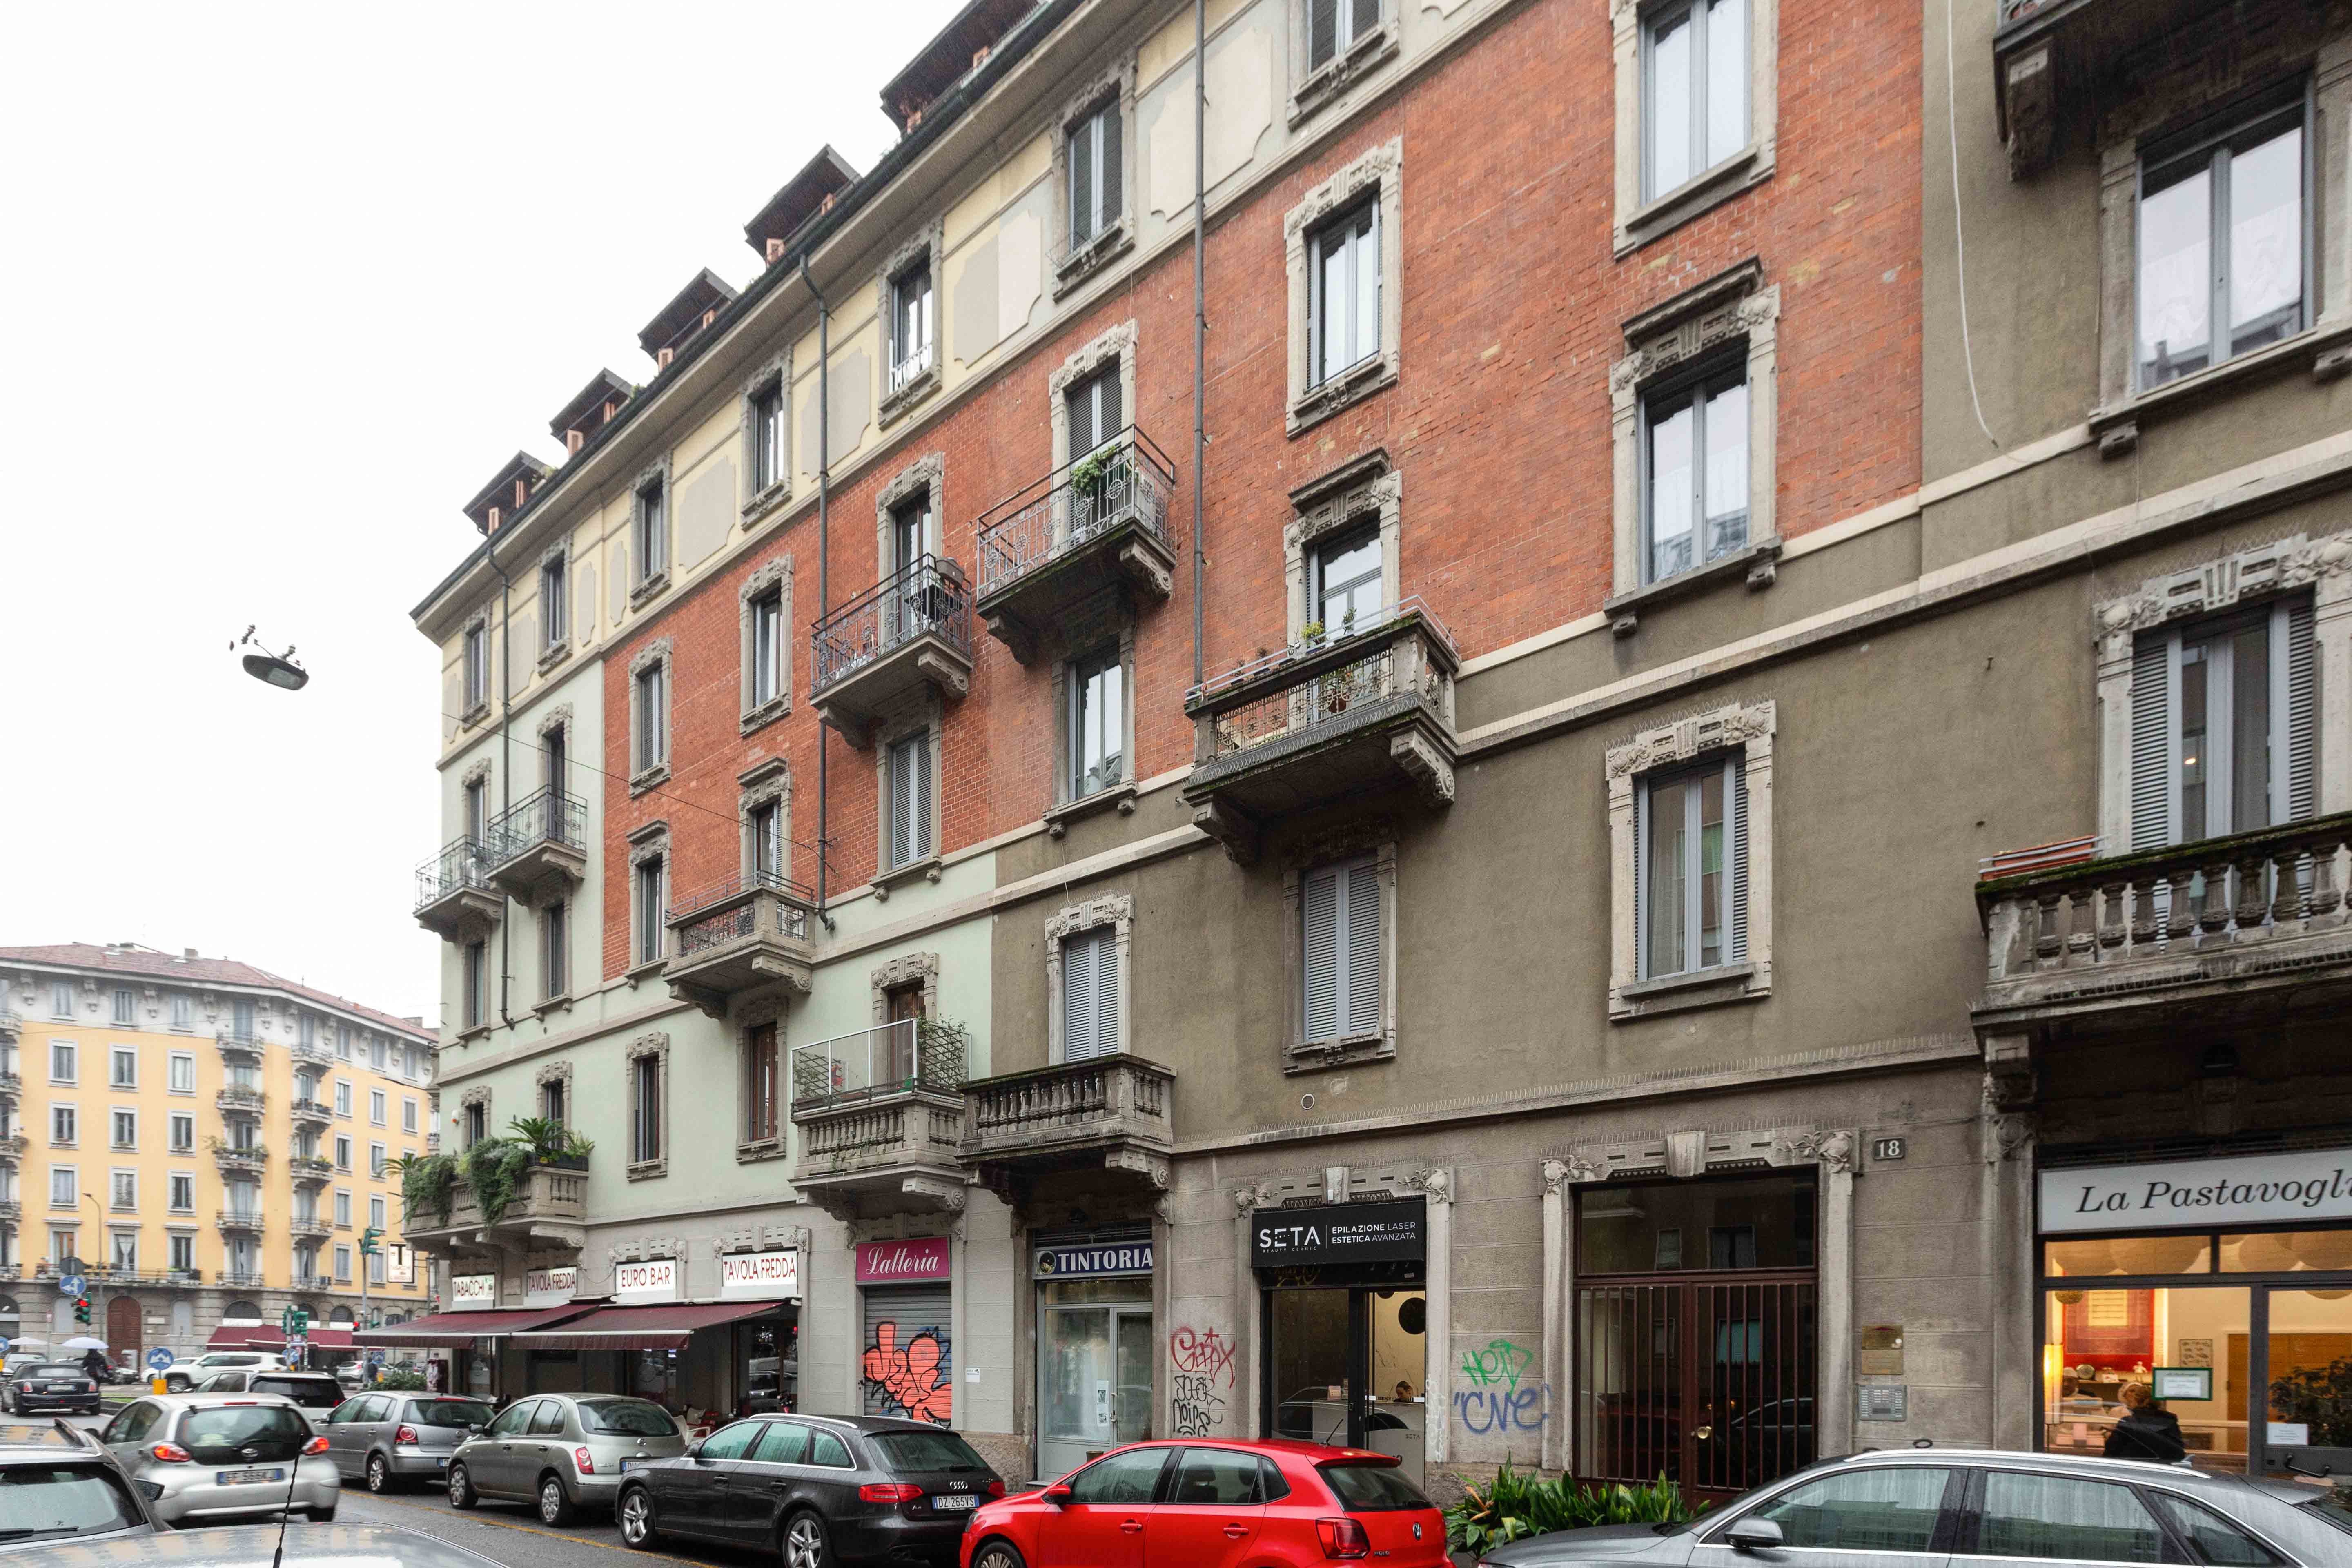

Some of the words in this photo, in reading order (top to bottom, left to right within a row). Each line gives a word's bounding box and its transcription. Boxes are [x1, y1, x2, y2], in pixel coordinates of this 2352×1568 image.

[1879, 1140, 1900, 1157] 18
[2075, 1186, 2130, 1213] La
[1259, 1226, 1321, 1248] SETA
[1332, 1224, 1385, 1234] EPILAZIONE
[1388, 1222, 1416, 1231] LASER
[1332, 1235, 1371, 1244] ESTETICA
[1372, 1232, 1416, 1242] AVANZATA
[724, 1259, 759, 1281] TAVOLA
[761, 1257, 796, 1279] FREDDA
[865, 1246, 939, 1274] Latteria
[1058, 1248, 1153, 1272] TINTORIA
[528, 1273, 551, 1292] TAVOLA
[552, 1272, 575, 1290] FREDDA
[621, 1268, 647, 1287] EURO
[650, 1266, 670, 1285] BAR
[454, 1280, 485, 1297] TABACCHI
[938, 1497, 949, 1508] DZ
[951, 1496, 974, 1507] 265VS
